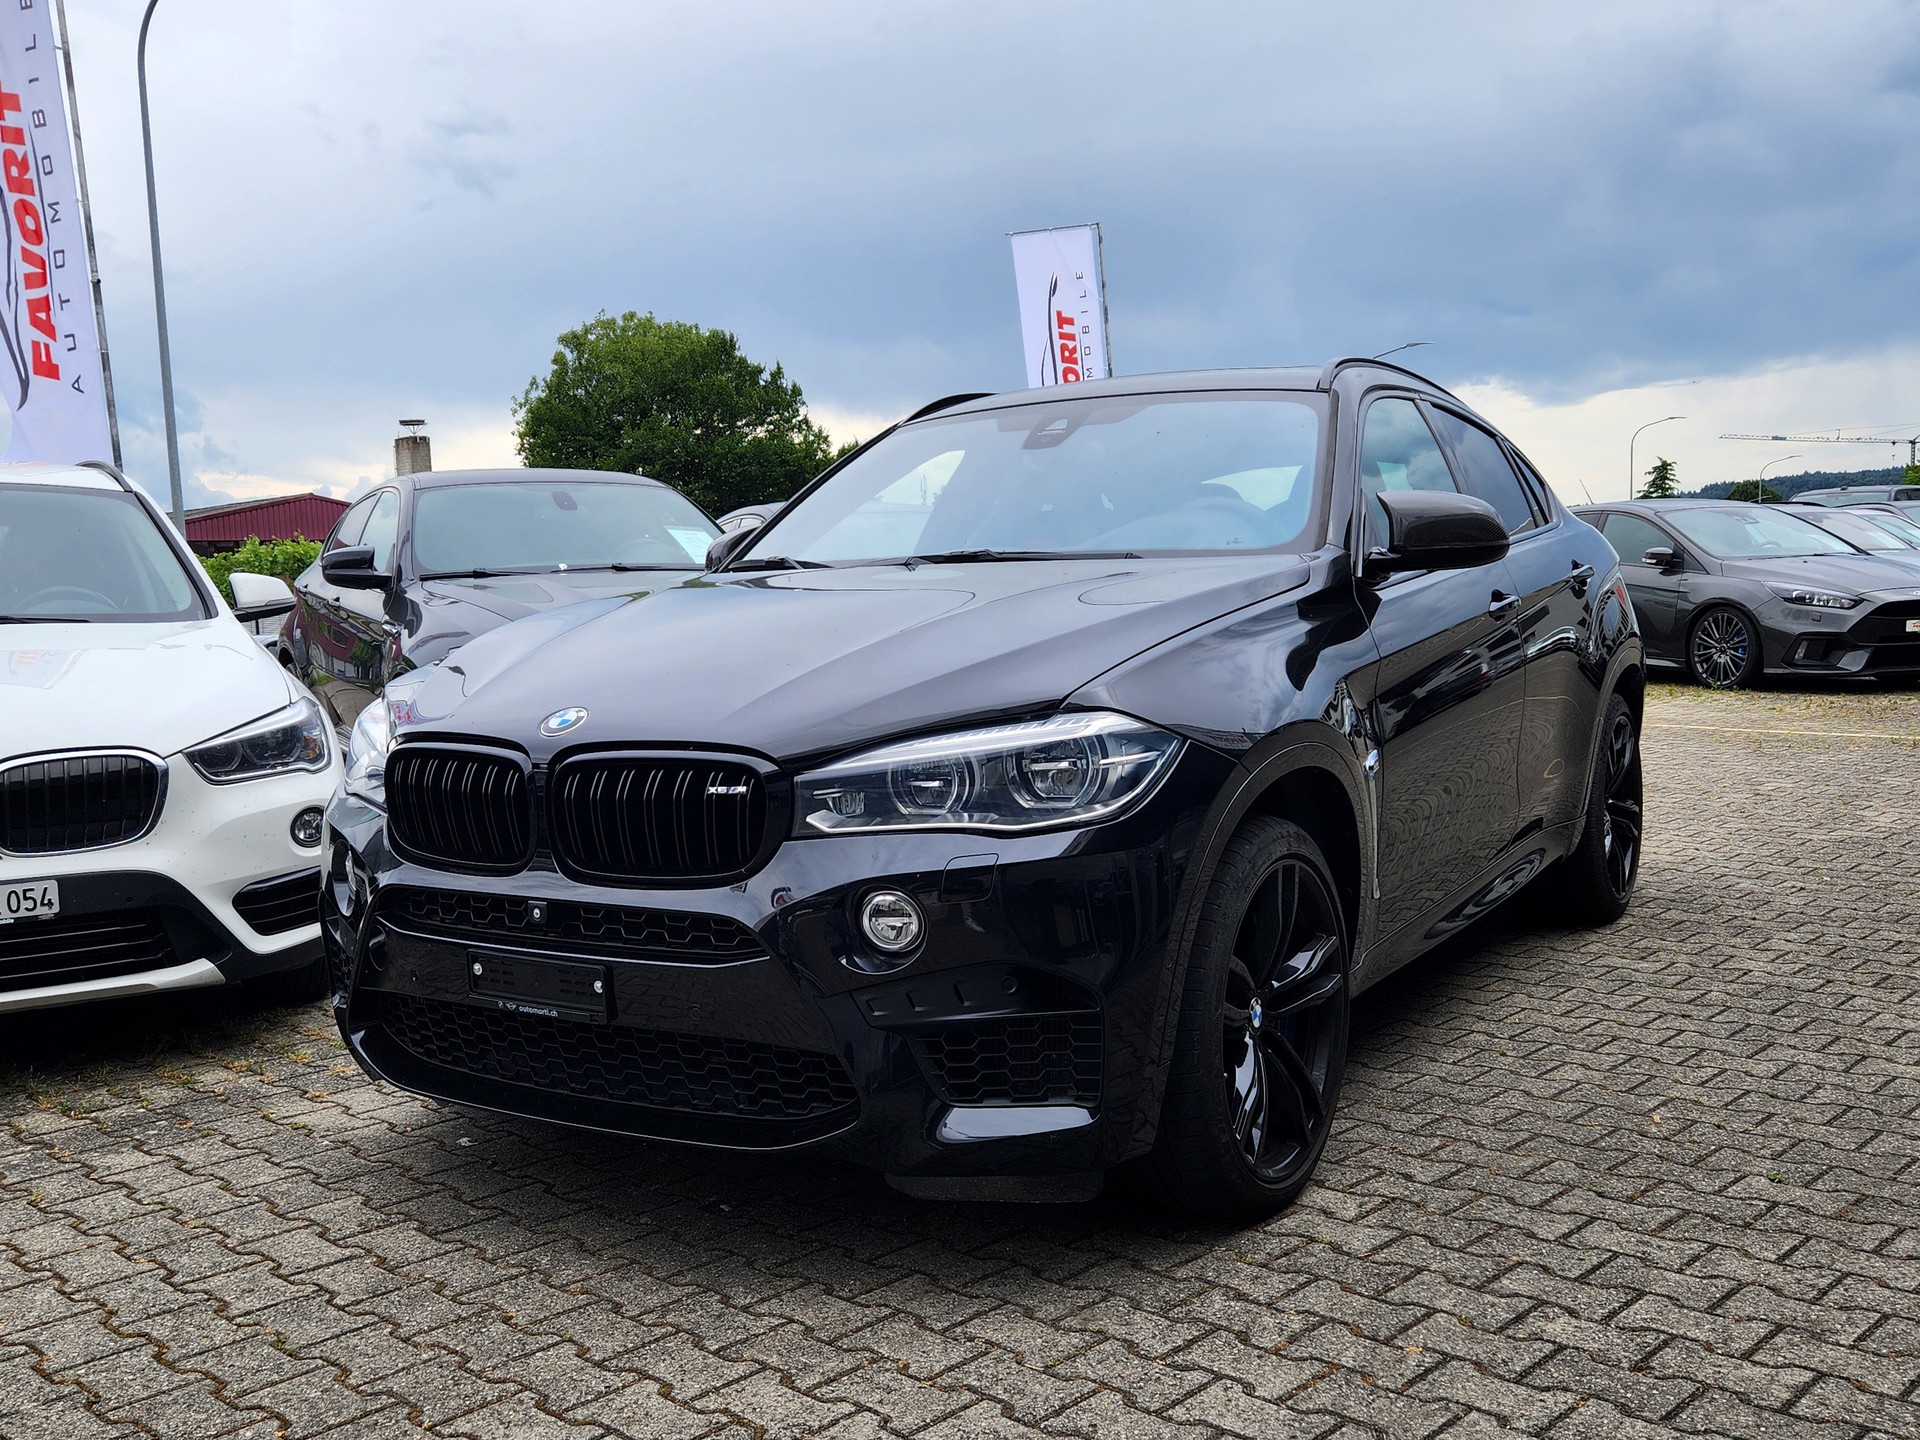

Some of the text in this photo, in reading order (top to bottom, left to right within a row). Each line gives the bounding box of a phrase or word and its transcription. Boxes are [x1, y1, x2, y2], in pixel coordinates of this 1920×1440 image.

[0, 81, 61, 382] FAVORIT
[1075, 271, 1094, 379] MOBILE
[6, 886, 54, 914] 054
